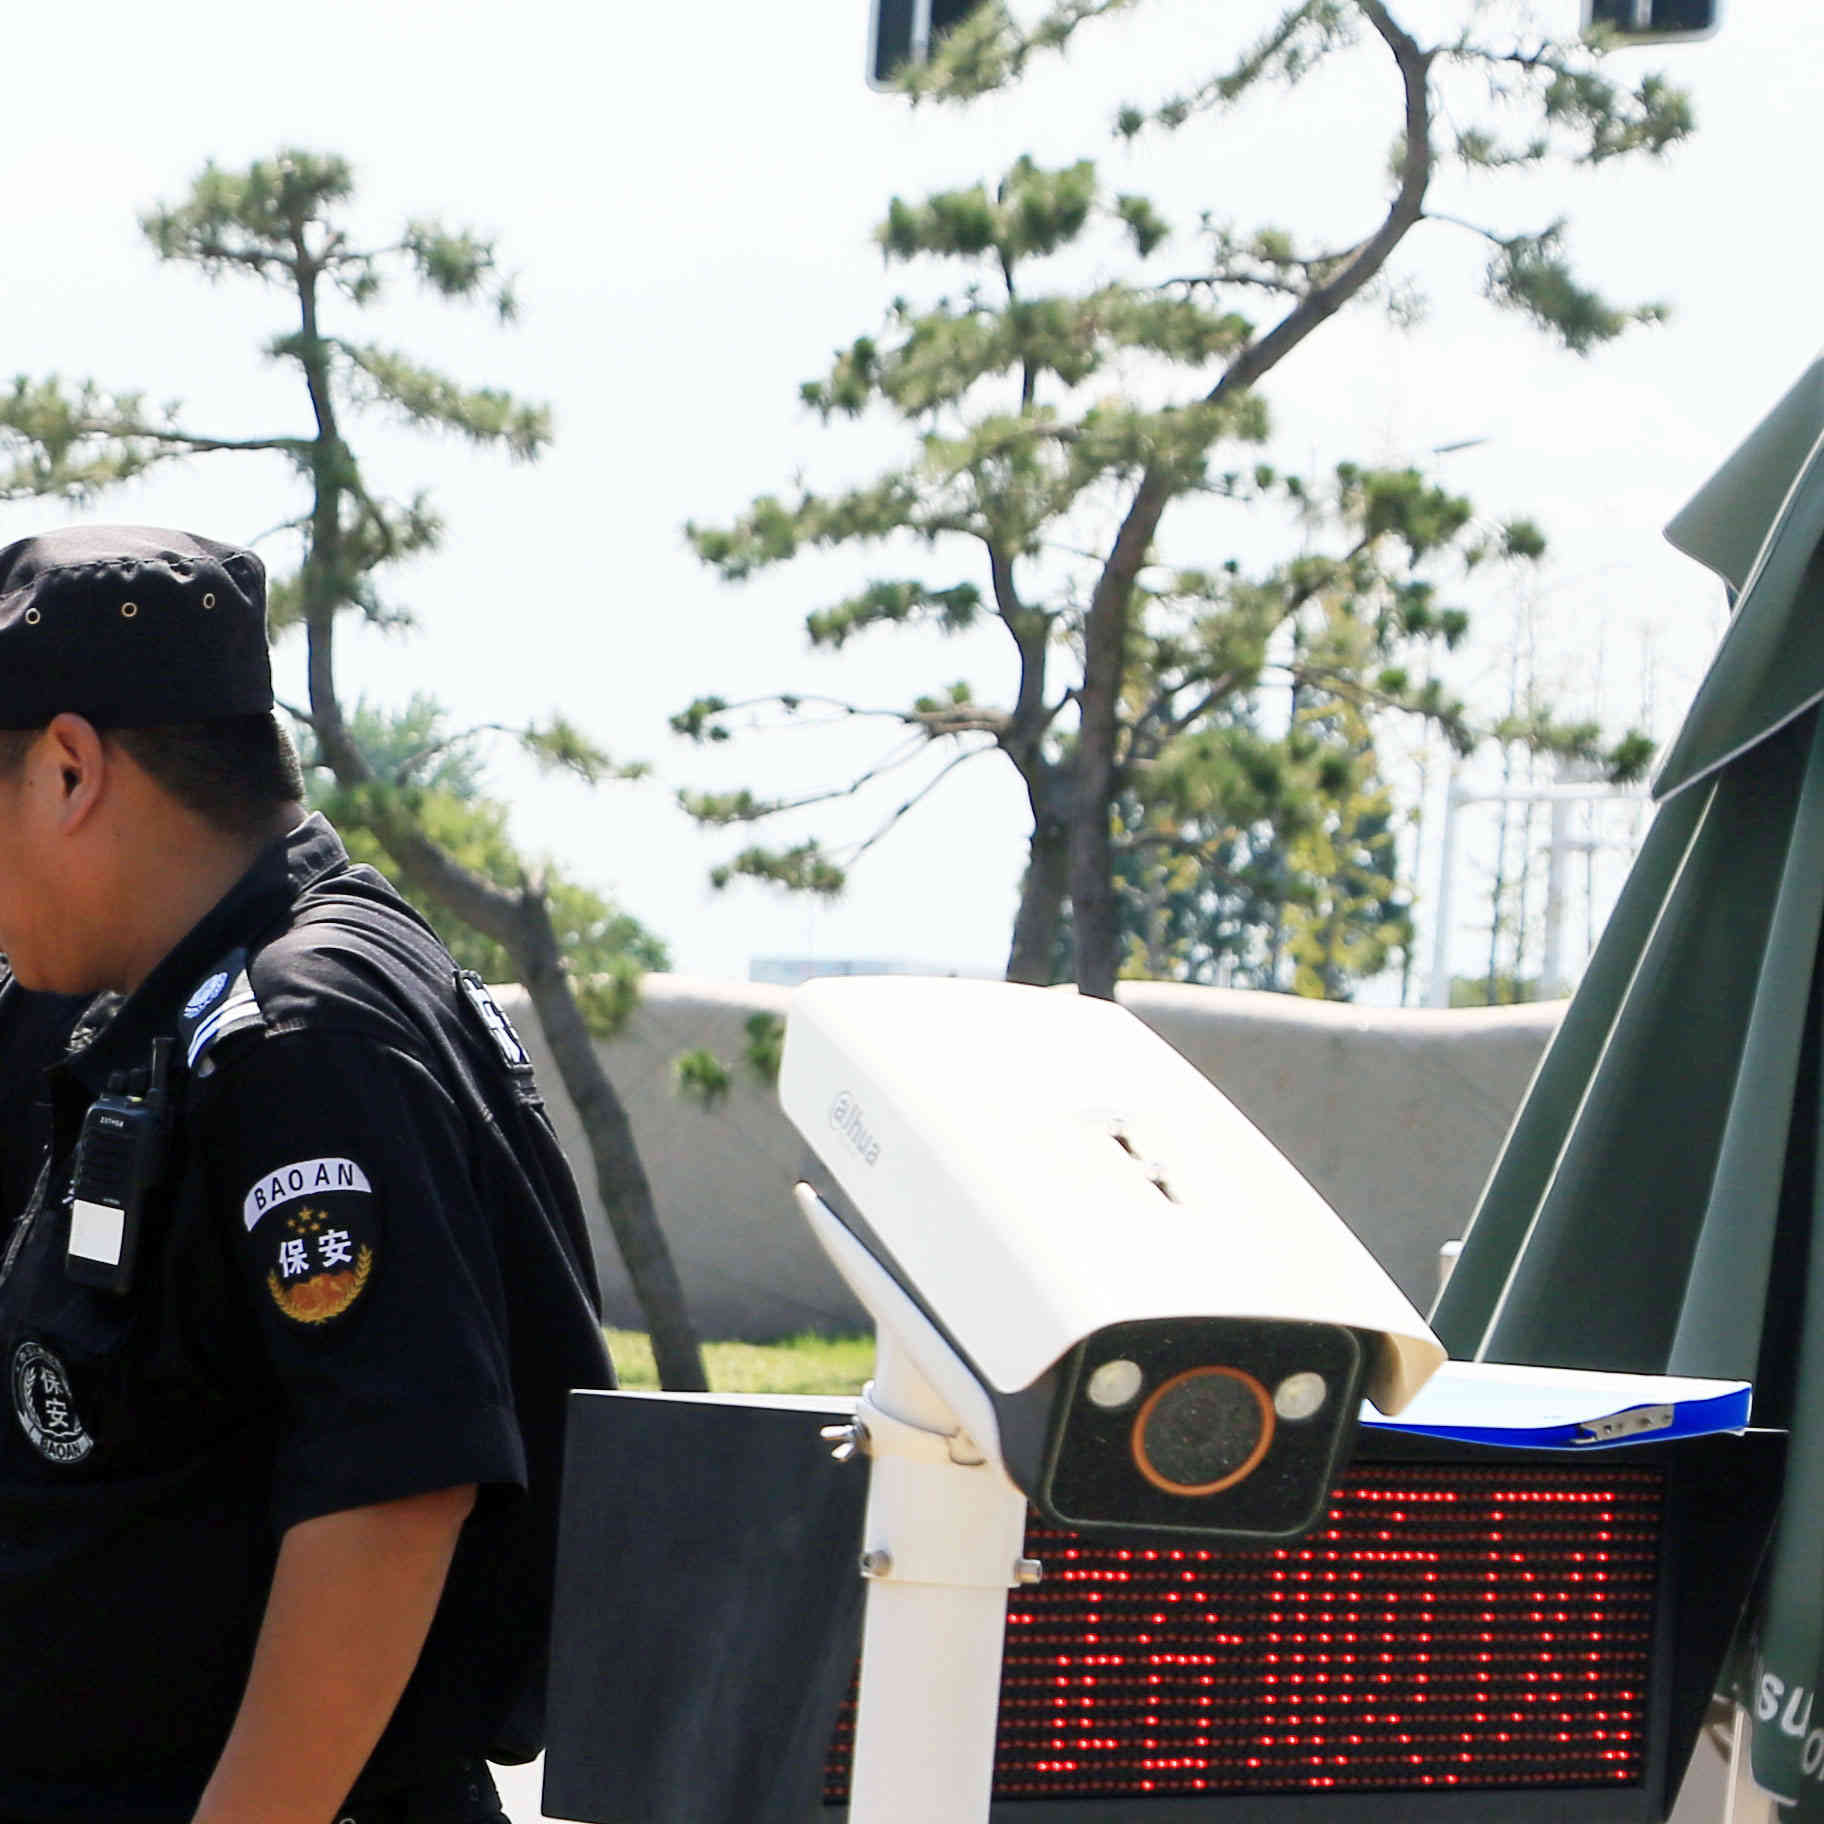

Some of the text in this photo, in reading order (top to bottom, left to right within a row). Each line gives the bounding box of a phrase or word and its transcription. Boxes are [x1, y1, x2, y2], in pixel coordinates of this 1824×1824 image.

[277, 1229, 353, 1278] 保安
[1006, 1488, 1636, 1790] 路顺风
